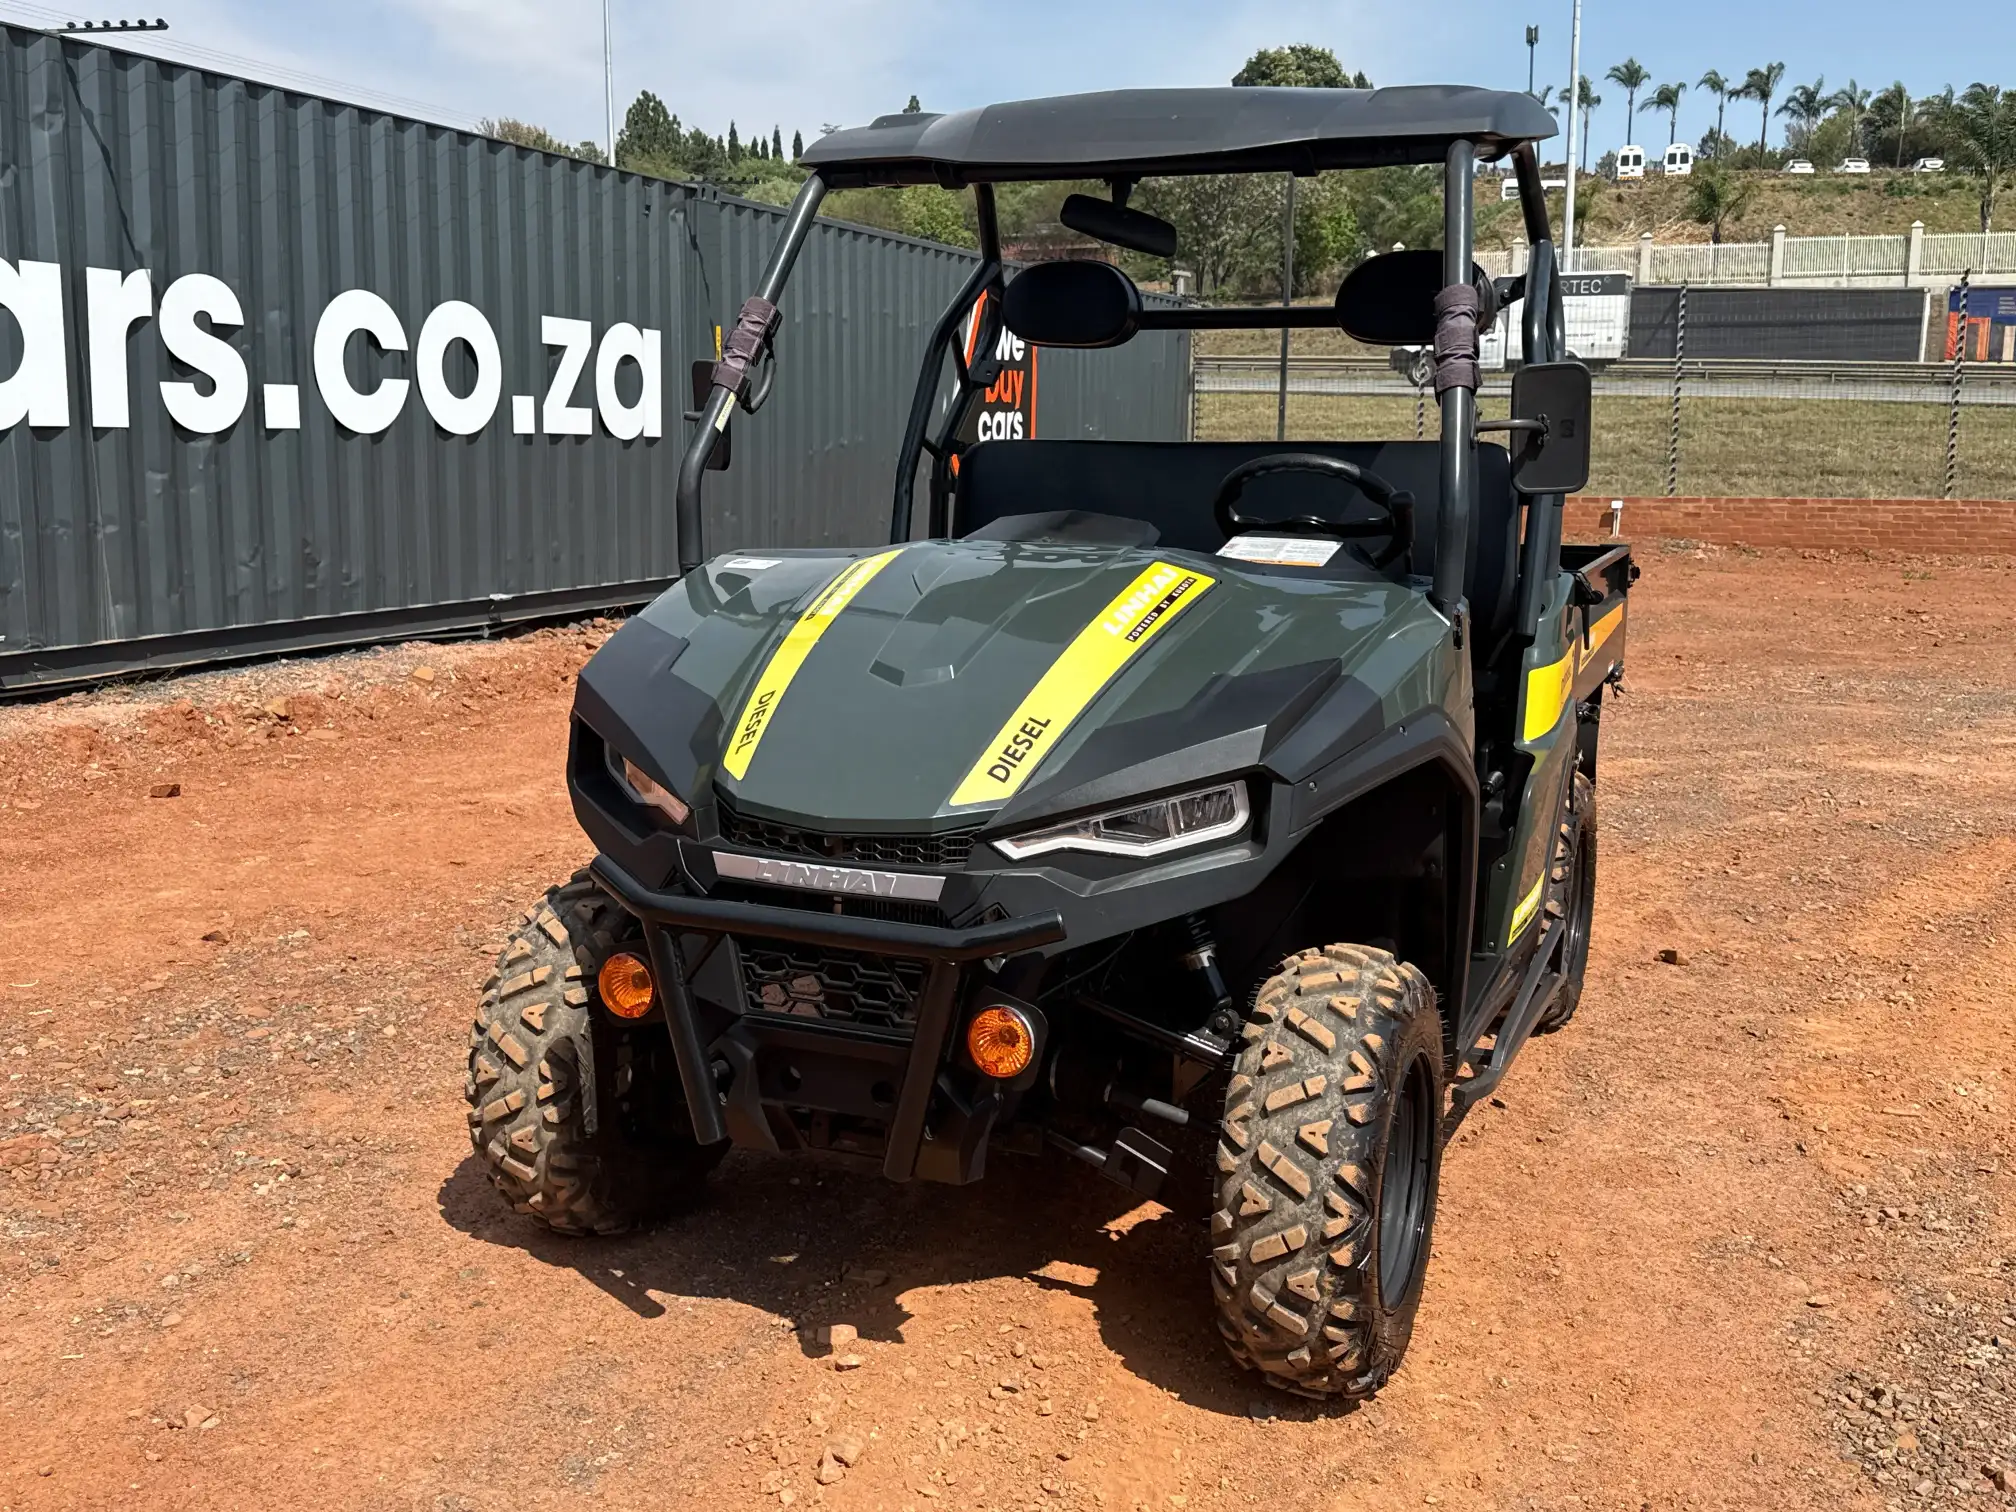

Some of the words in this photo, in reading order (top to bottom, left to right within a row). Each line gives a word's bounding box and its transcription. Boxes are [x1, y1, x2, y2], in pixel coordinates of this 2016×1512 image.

[978, 411, 1024, 442] cars
[1103, 567, 1178, 635] LINHAI
[1128, 611, 1159, 641] POWERED
[1160, 600, 1171, 609] BY
[1171, 578, 1195, 598] KUBOTA
[735, 690, 776, 755] DIESEL
[987, 717, 1051, 783] DIESEL
[755, 860, 897, 895] LINHAI
